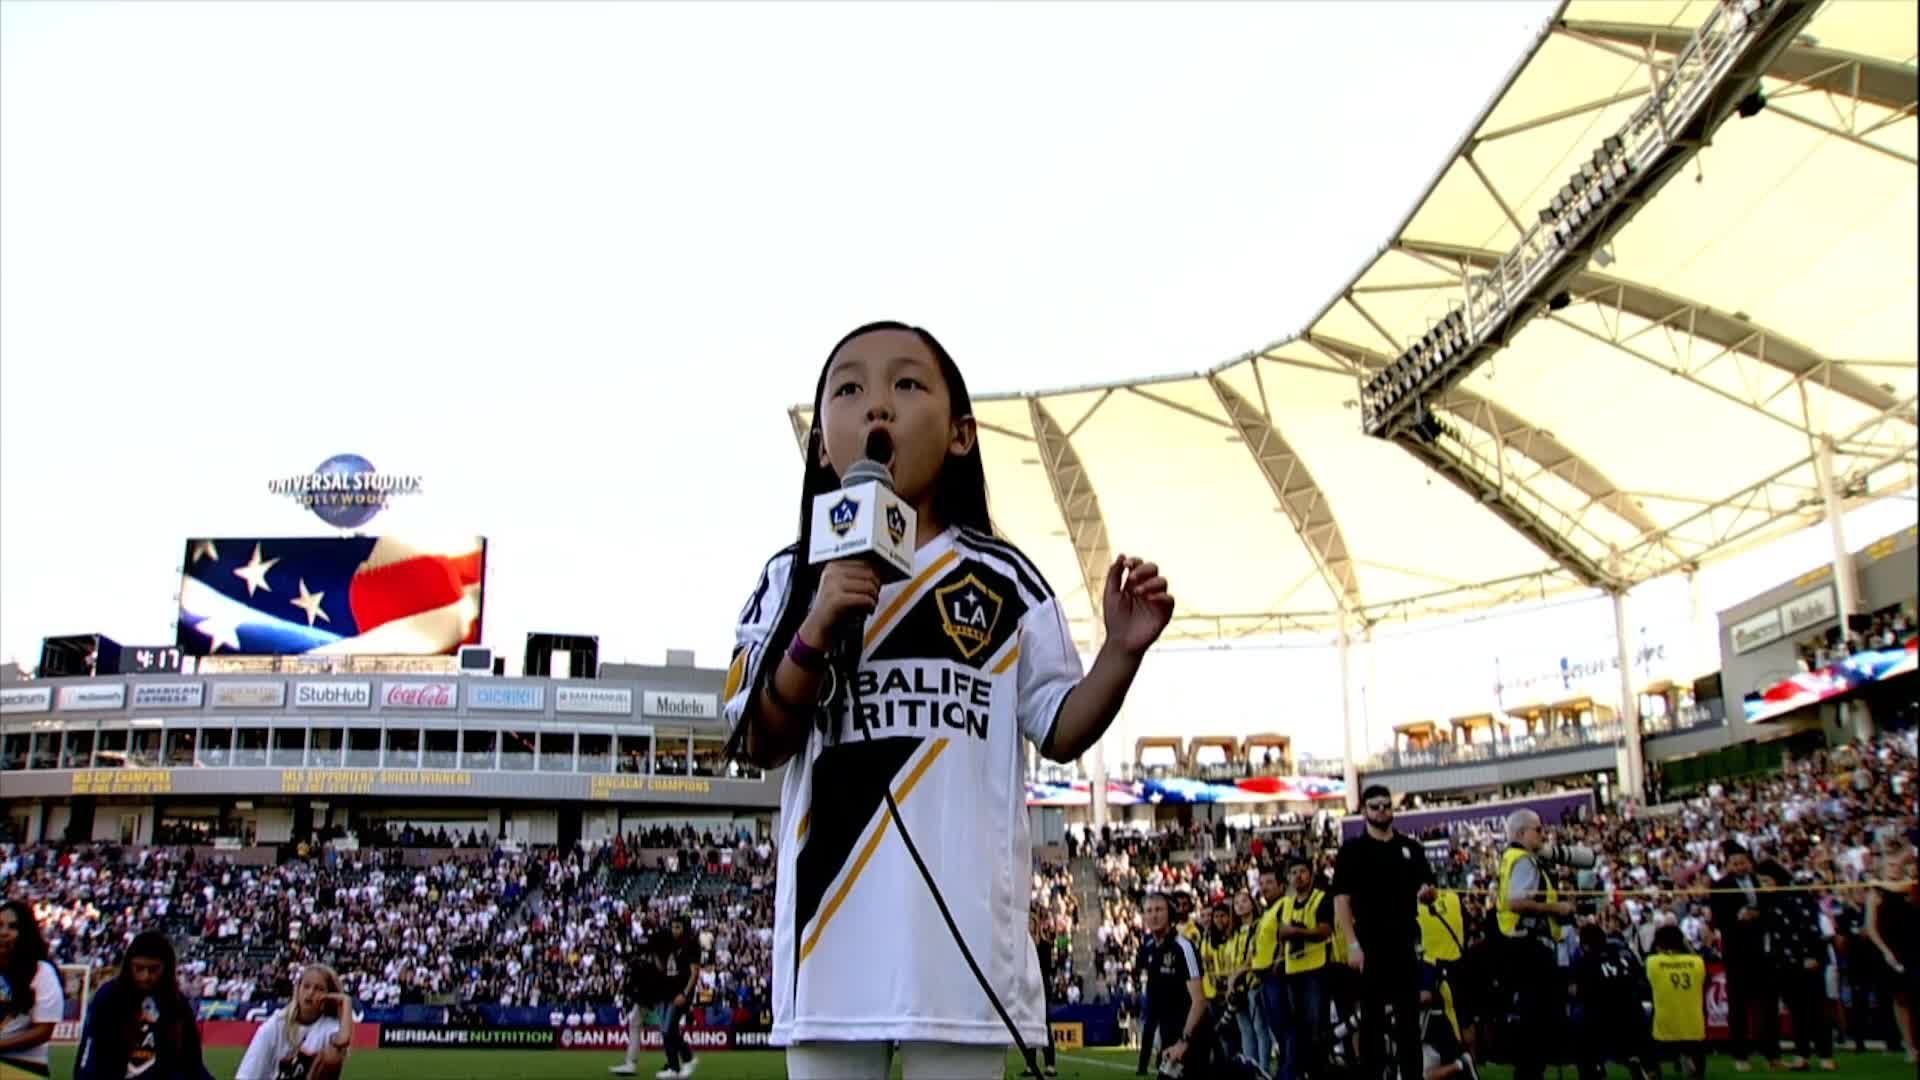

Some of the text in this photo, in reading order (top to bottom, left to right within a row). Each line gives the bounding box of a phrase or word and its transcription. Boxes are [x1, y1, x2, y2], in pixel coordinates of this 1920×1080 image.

[834, 508, 854, 523] LA
[954, 601, 988, 629] LA
[136, 648, 180, 669] 4:17
[137, 686, 200, 696] AMERICAN
[299, 687, 367, 702] StubHub
[856, 667, 992, 707] BALIFE
[656, 696, 704, 714] Modelo
[853, 700, 989, 740] RITION
[1670, 971, 1692, 990] 93
[384, 1029, 554, 1043] HERBALIFE NUTRITION
[573, 1030, 604, 1044] SAN
[682, 1030, 728, 1044] ASINO
